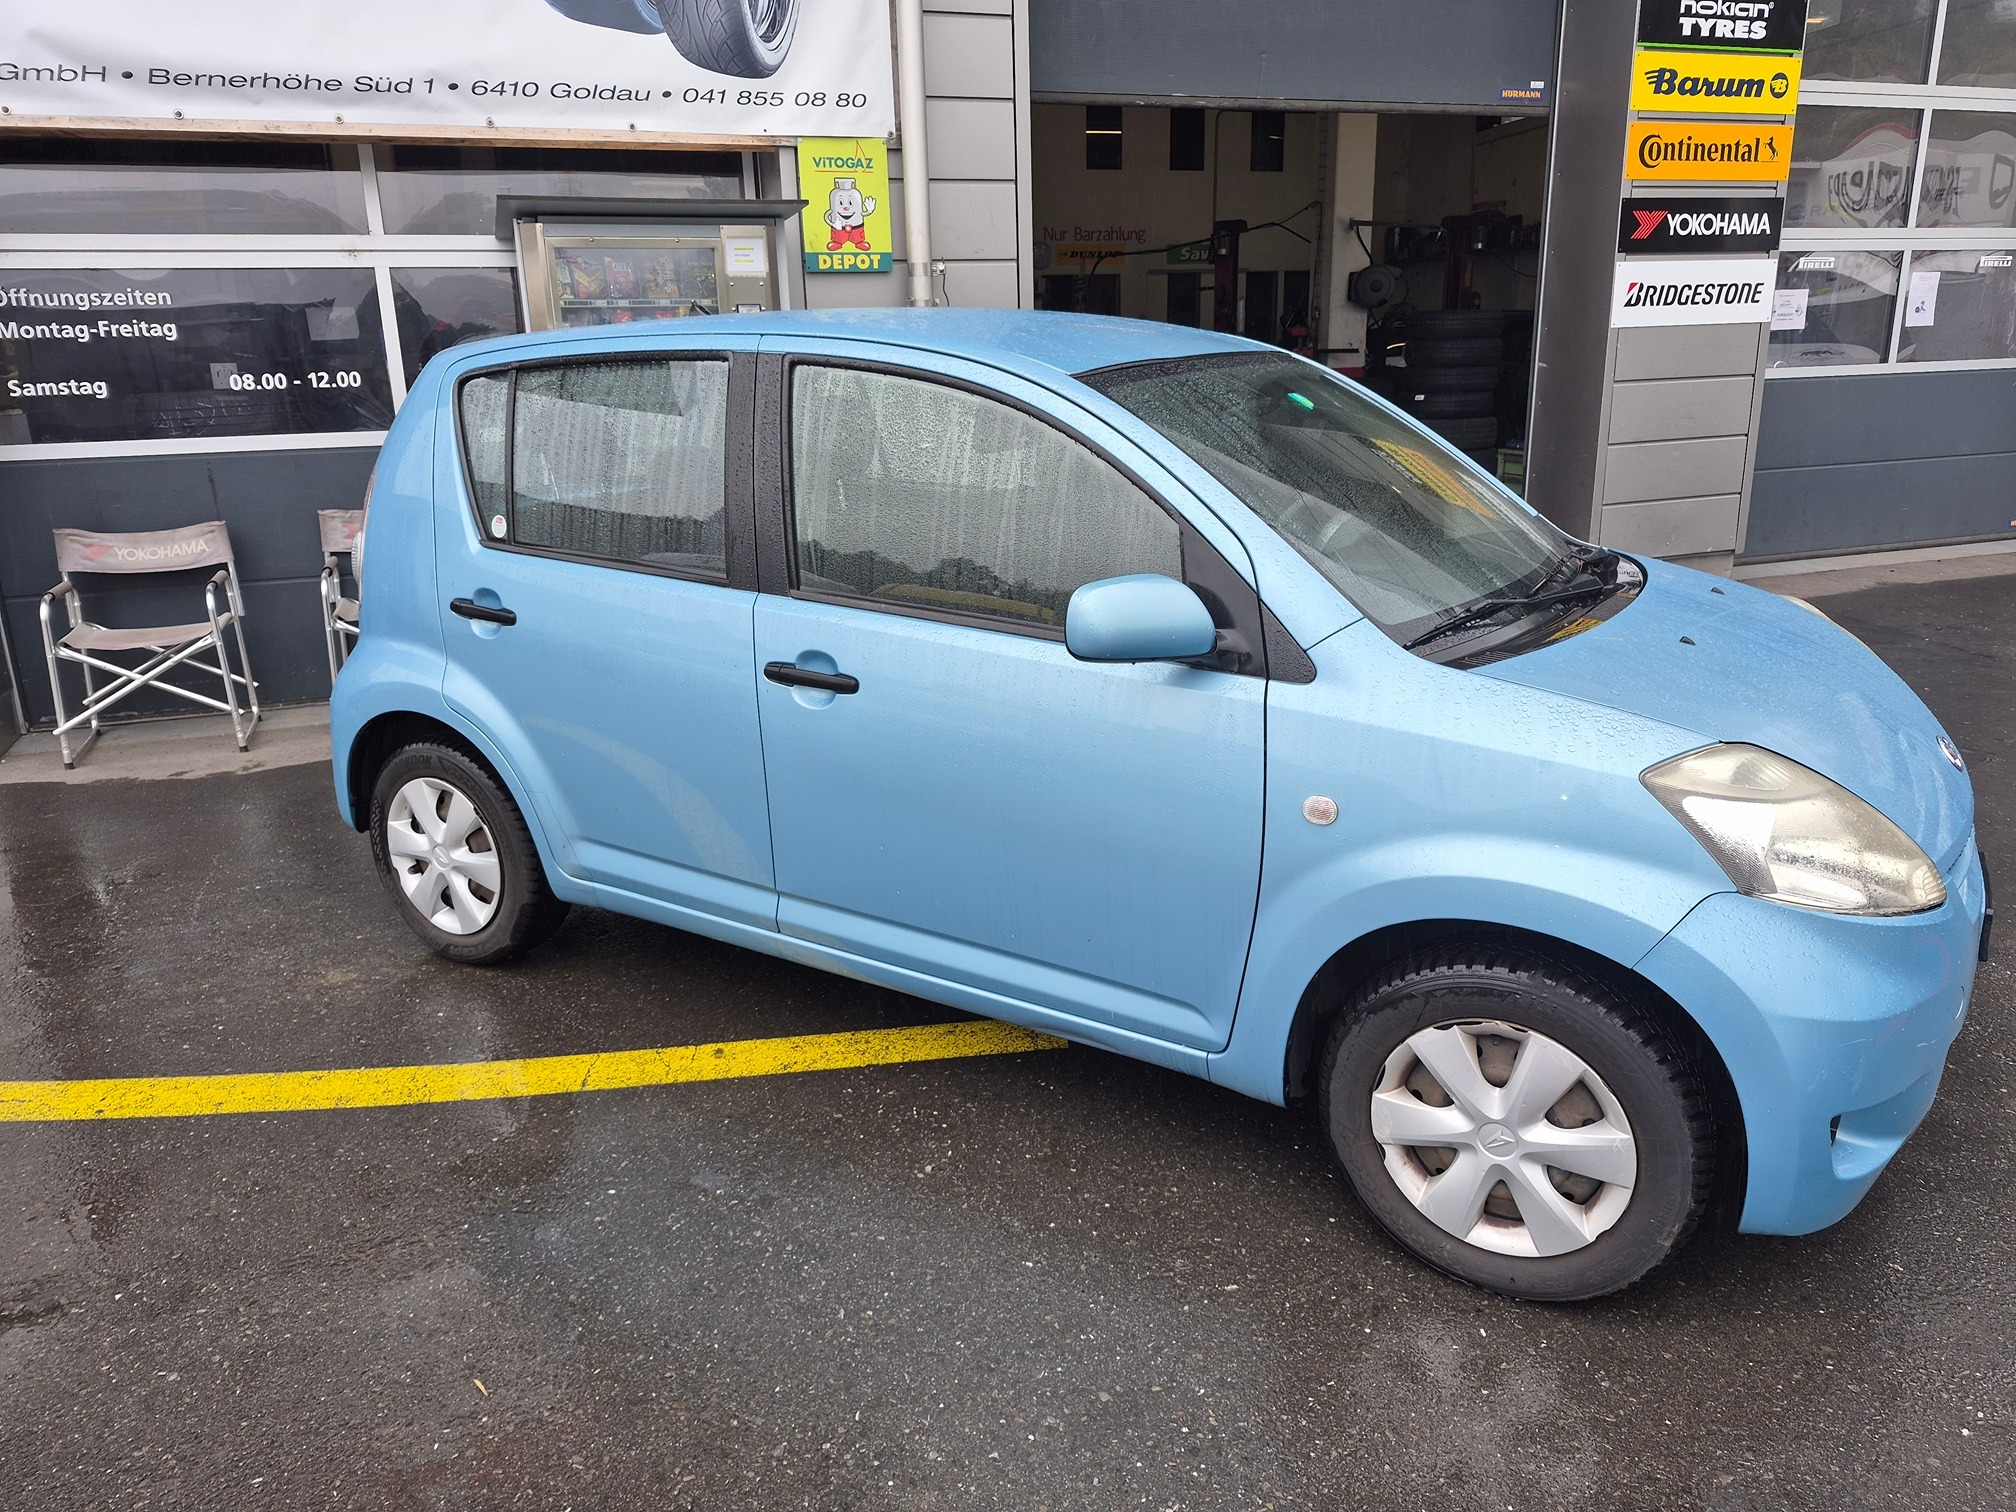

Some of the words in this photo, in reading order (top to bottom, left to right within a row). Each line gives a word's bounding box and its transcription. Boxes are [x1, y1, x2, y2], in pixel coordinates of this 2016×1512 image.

[1679, 17, 1767, 40] TYRES
[0, 63, 107, 82] GmbH
[148, 67, 343, 92] Bernerhöhe
[353, 75, 414, 94] Süd
[423, 78, 435, 94] 1
[471, 79, 539, 98] 6410
[550, 82, 652, 102] Goldau
[683, 88, 726, 104] 041
[737, 90, 785, 107] 855
[795, 91, 827, 107] 08
[836, 92, 867, 108] 80
[1644, 68, 1766, 97] Barum
[1639, 133, 1761, 169] Continental
[1043, 226, 1068, 242] Nur
[1074, 225, 1146, 244] Barzahlung
[1667, 213, 1771, 236] YOKOHAMA
[818, 254, 881, 270] DEPOT
[1796, 256, 1836, 269] PIRELLI
[1980, 255, 2013, 267] PIRELLI
[1623, 281, 1765, 307] BRIDGESTONE
[0, 320, 178, 343] Montag-Freitag
[7, 378, 108, 400] Samstag
[229, 372, 288, 391] 08.00
[307, 371, 361, 389] 12.00
[114, 539, 209, 560] YOKOHAMA
